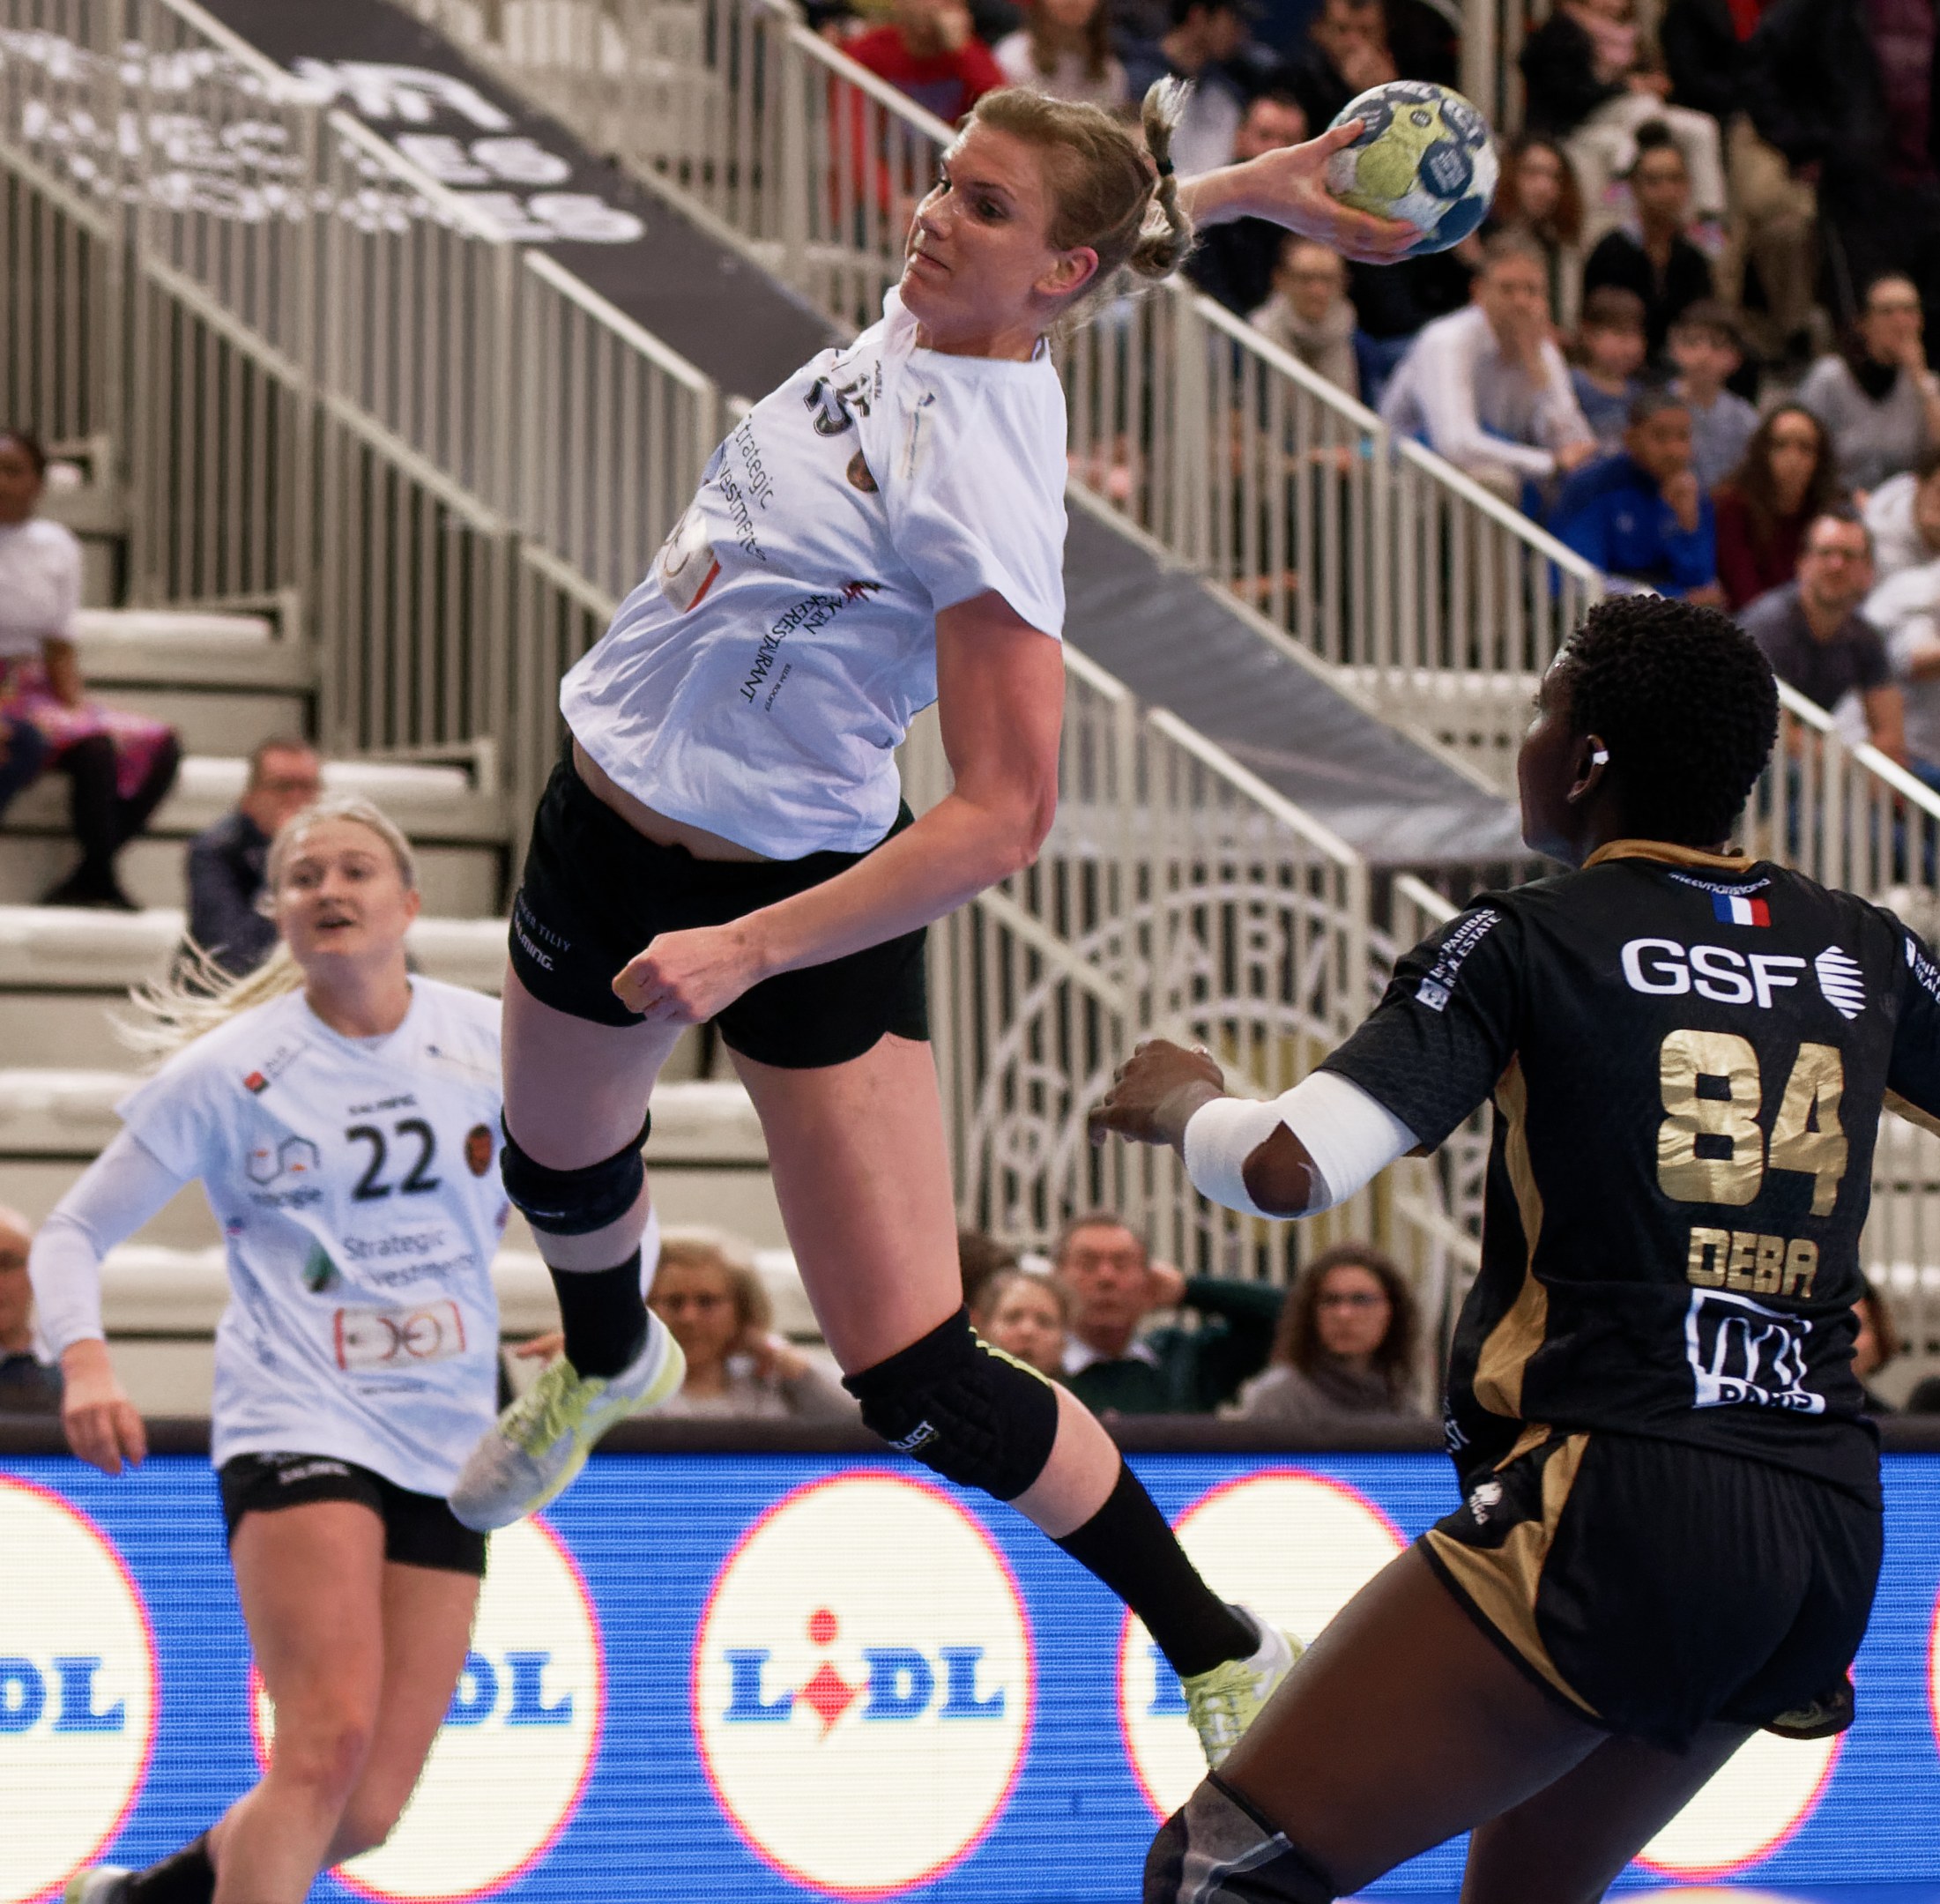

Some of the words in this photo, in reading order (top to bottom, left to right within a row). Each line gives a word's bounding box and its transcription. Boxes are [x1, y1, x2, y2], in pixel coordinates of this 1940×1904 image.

[735, 413, 774, 509] trategic
[1441, 909, 1496, 953] PARIBAS
[1456, 914, 1502, 957] ESTATE
[1620, 937, 1806, 1009] GSF
[346, 1117, 439, 1203] 22
[1657, 1029, 1848, 1217] 84
[1686, 1225, 1818, 1298] DEBA
[0, 1656, 125, 1732] DL
[442, 1650, 573, 1727] DL
